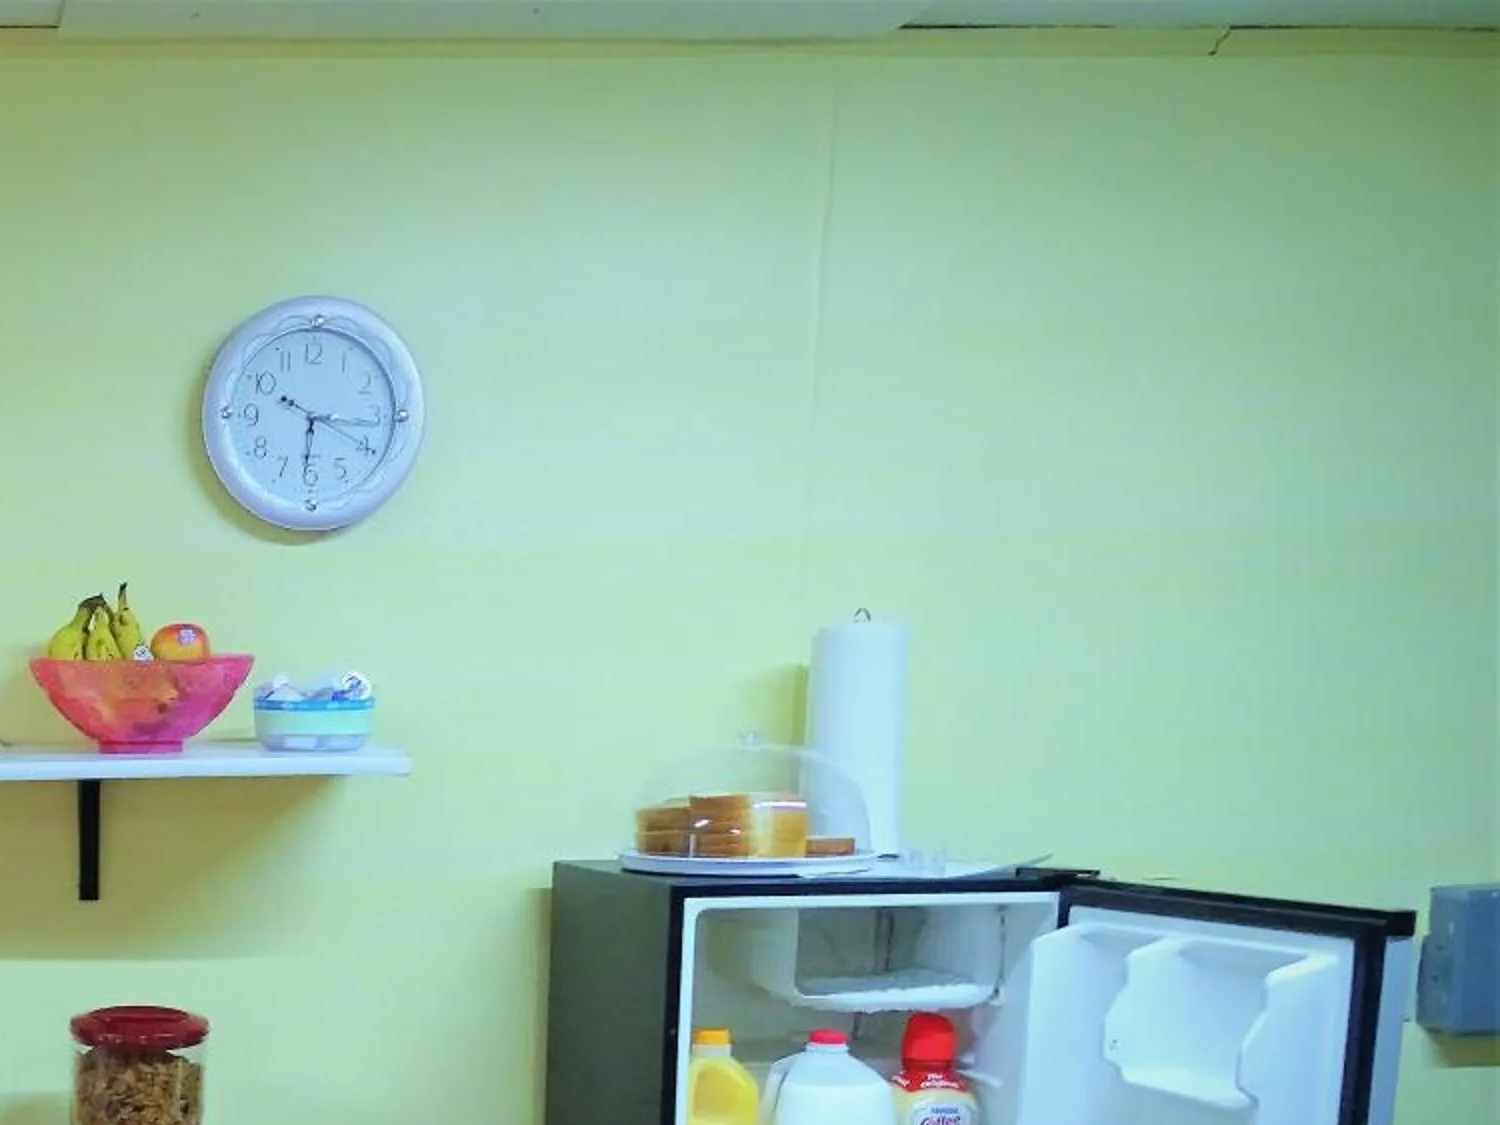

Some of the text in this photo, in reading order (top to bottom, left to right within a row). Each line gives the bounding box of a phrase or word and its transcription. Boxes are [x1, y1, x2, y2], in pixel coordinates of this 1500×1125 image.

[280, 350, 291, 373] 11
[304, 343, 323, 365] 12
[255, 370, 276, 396] 10
[357, 371, 372, 394] 2
[243, 403, 259, 427] 9
[367, 404, 381, 427] 3
[253, 436, 267, 460] 8
[355, 435, 371, 457] 4
[278, 455, 289, 478] 7
[302, 462, 319, 487] 6
[333, 457, 347, 481] 5
